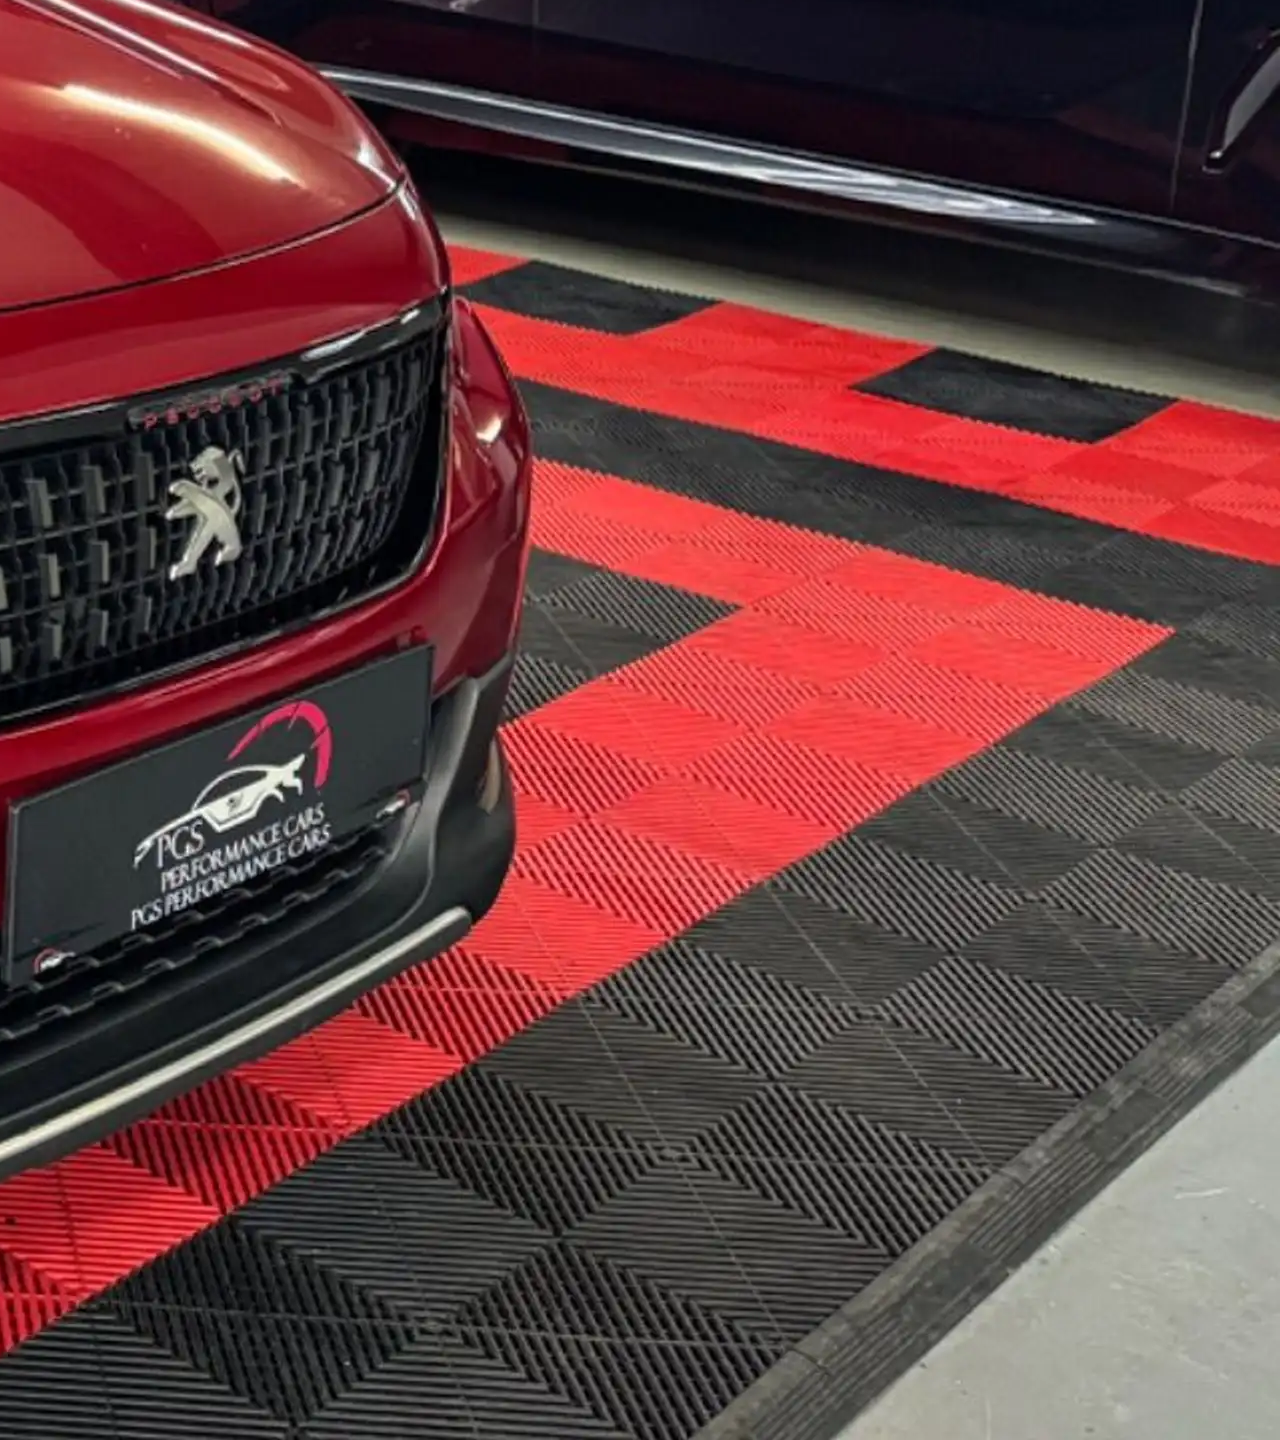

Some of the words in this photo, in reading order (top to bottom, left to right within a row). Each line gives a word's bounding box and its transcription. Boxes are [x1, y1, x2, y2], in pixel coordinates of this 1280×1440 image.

[161, 821, 282, 893] PERFORMANCE
[283, 803, 325, 837] CARS
[164, 843, 286, 917] PERFORMANCE
[288, 824, 332, 858] CARS
